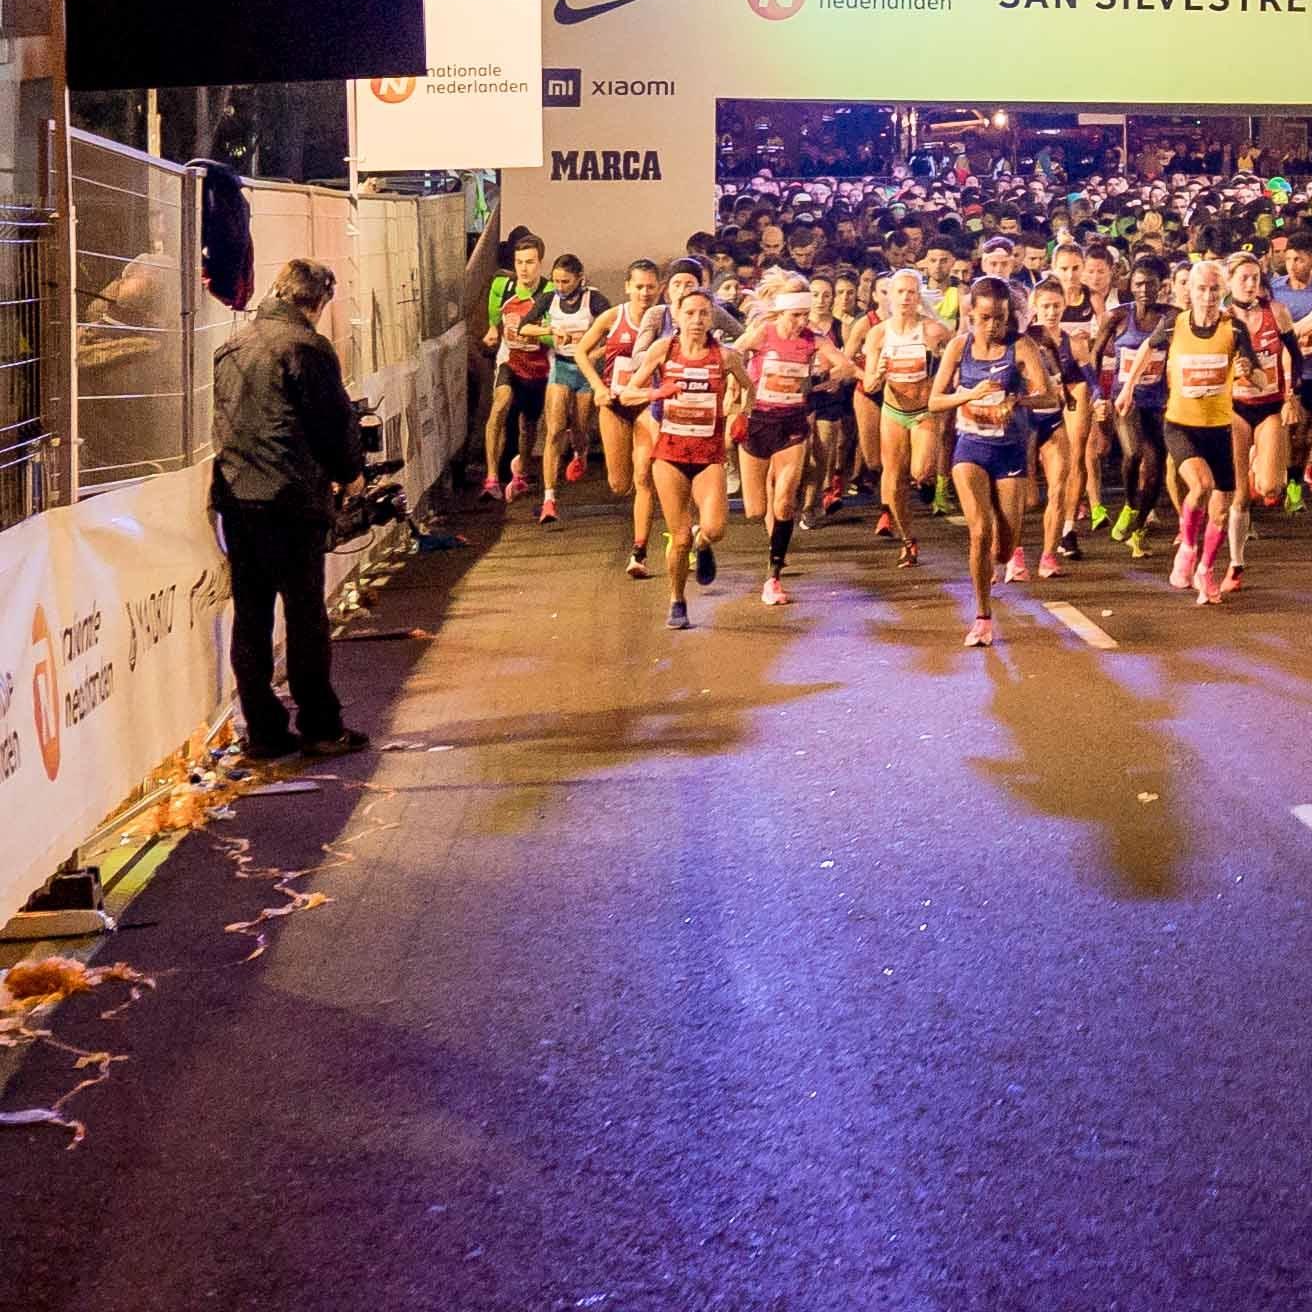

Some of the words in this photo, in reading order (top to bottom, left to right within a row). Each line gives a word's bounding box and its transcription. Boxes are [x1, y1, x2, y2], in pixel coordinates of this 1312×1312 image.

[426, 63, 503, 78] nationale
[426, 79, 529, 94] nederlanden
[591, 79, 676, 97] xiaomi
[550, 149, 662, 181] MARCA
